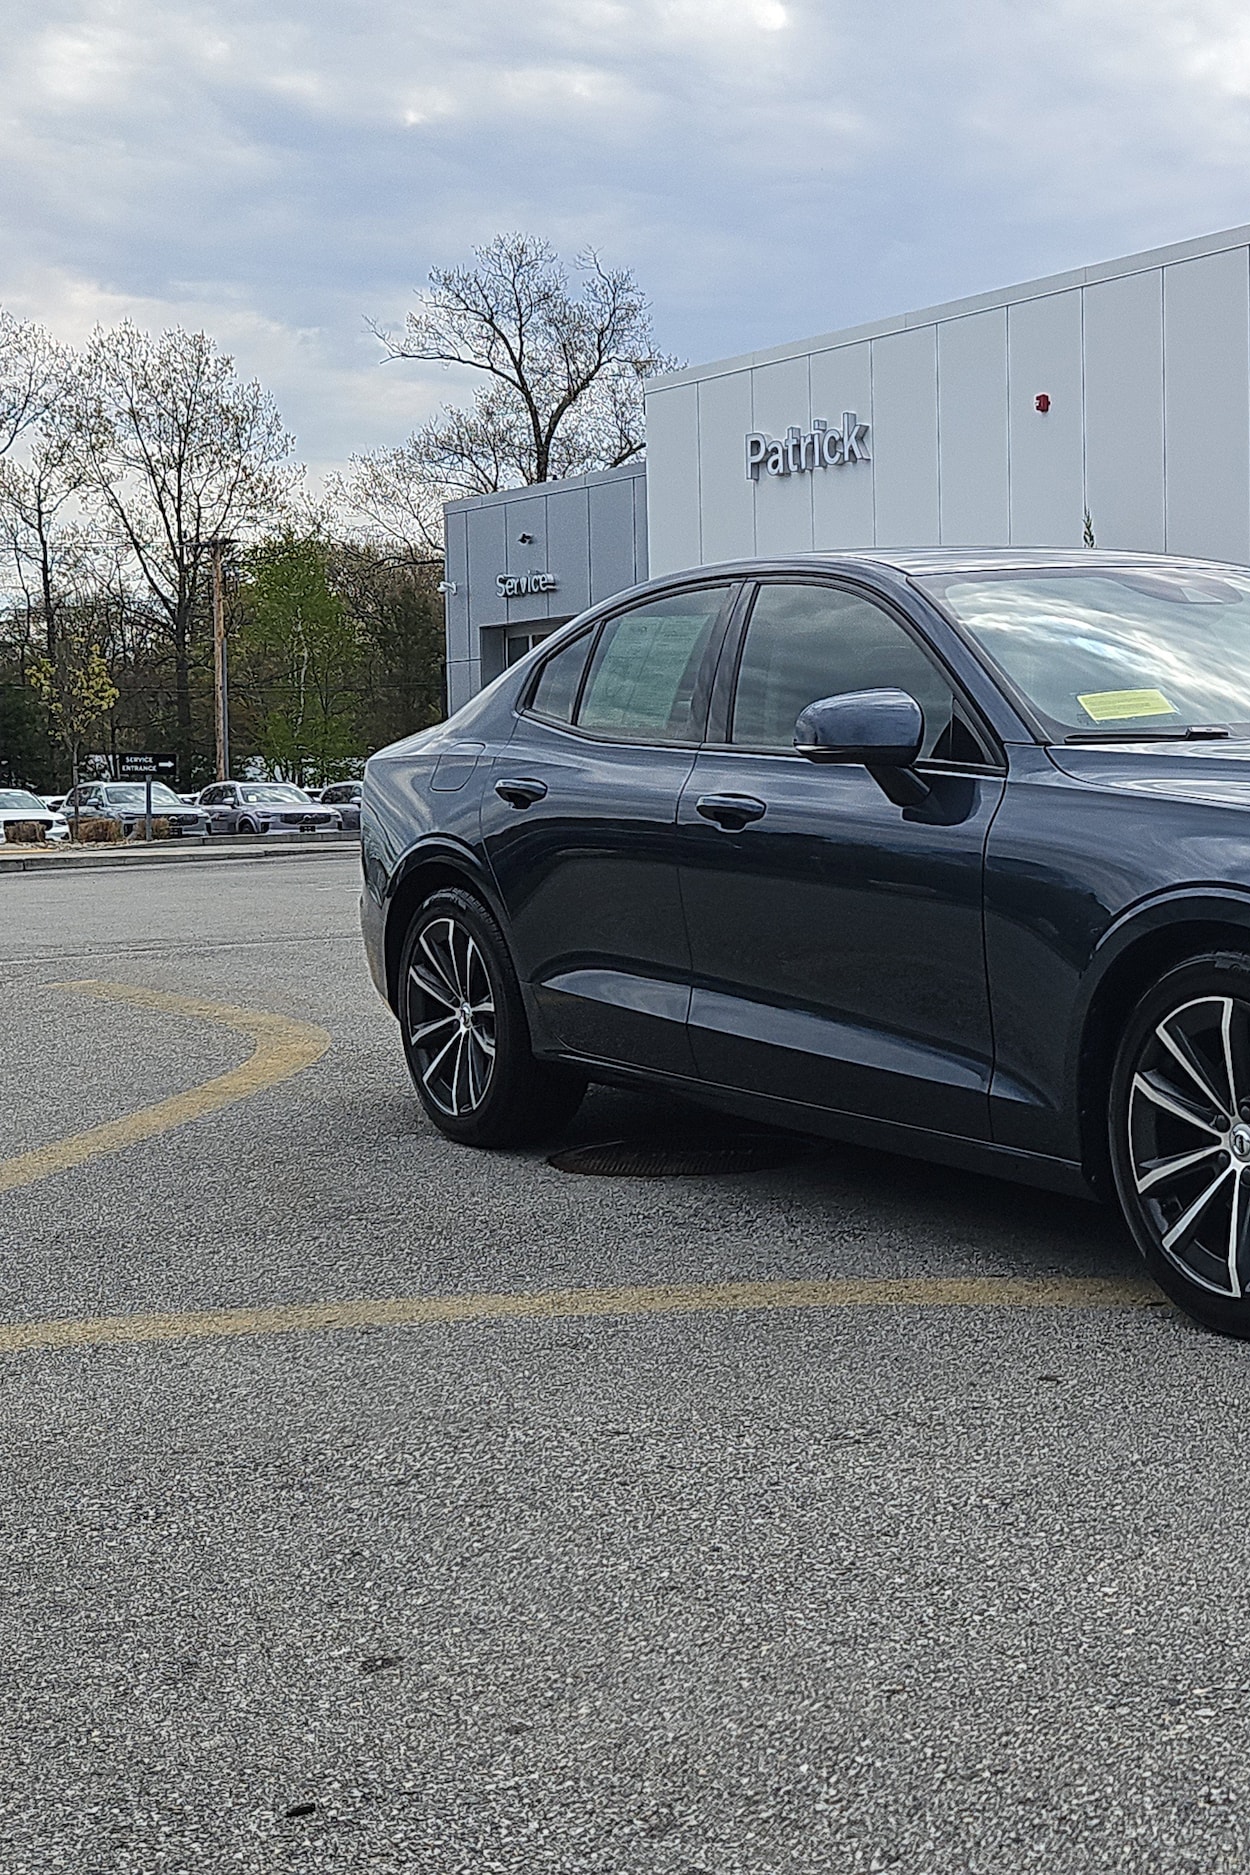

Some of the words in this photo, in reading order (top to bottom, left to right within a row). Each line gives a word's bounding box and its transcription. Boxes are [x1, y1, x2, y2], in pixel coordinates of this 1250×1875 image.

[744, 411, 871, 481] Patrick
[496, 570, 556, 597] Service
[121, 764, 157, 772] ENTRANCE
